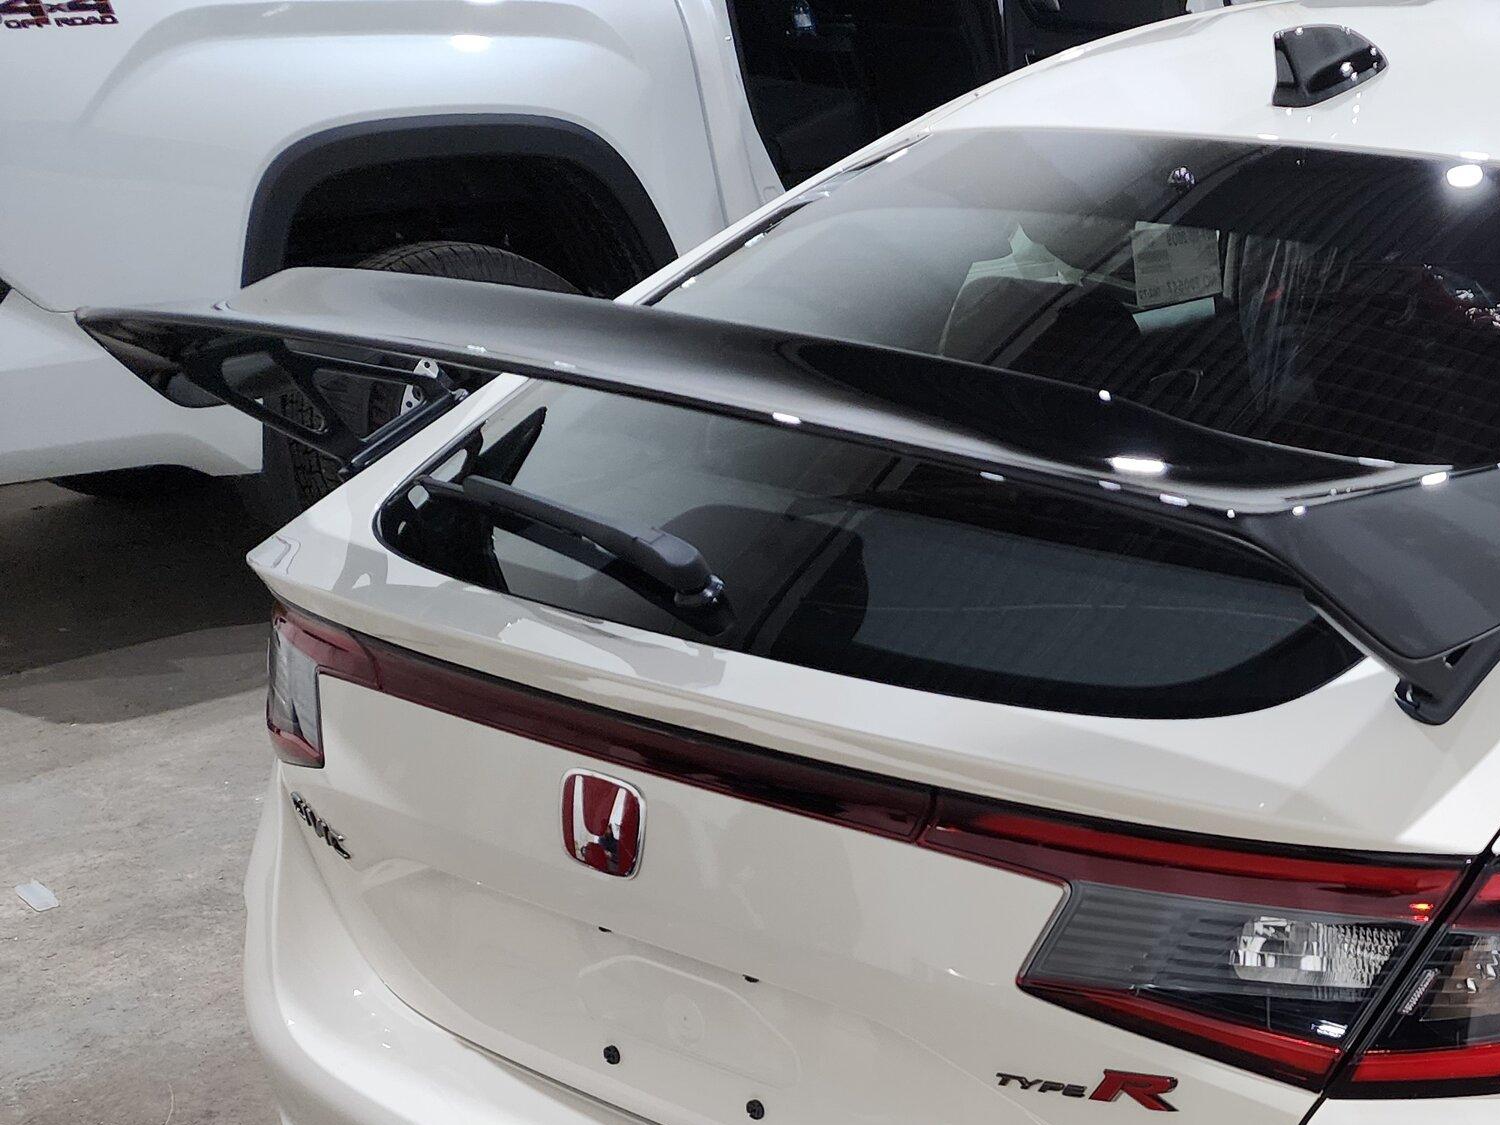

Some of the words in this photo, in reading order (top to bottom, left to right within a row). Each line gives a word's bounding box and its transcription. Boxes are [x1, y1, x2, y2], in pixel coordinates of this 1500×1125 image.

[4, 17, 51, 29] OFF
[53, 15, 119, 27] ROAD
[995, 1072, 1088, 1098] TYPE
[1088, 1068, 1180, 1112] R
